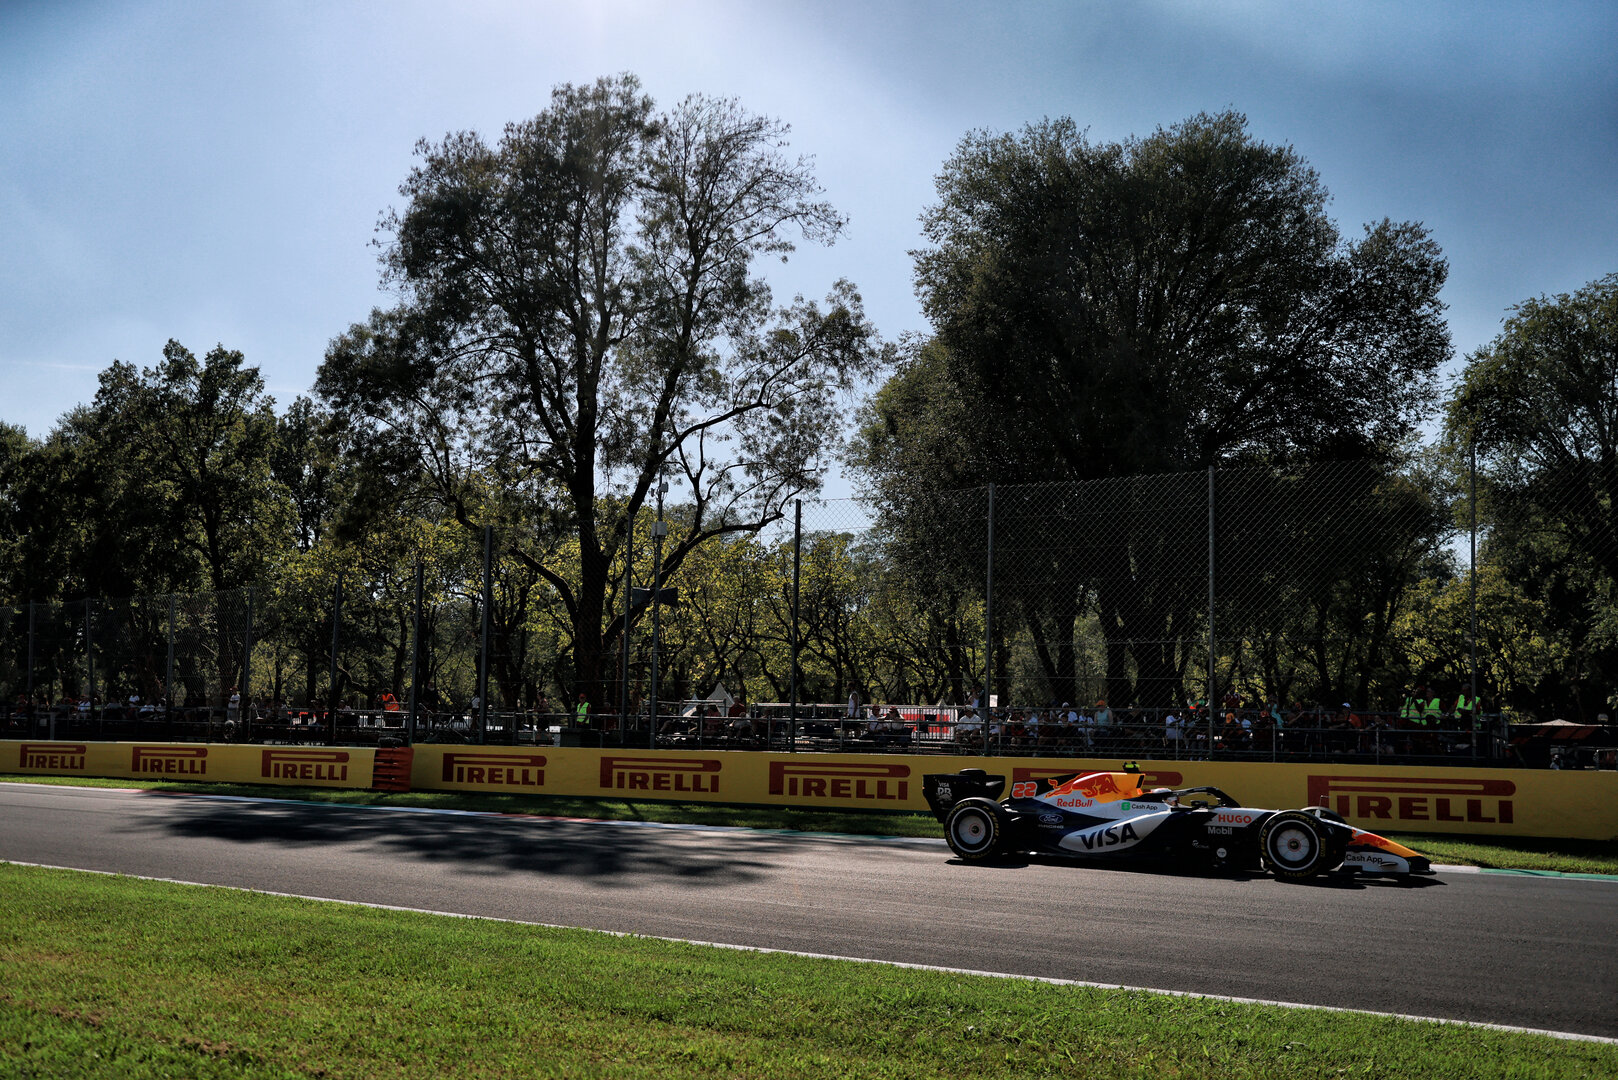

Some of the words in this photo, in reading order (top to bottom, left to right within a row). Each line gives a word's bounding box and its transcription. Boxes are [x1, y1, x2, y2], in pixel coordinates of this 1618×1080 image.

[20, 744, 87, 770] PIRELLI
[132, 746, 208, 775] PIRELLI
[261, 749, 349, 781] PIRELLI
[442, 752, 547, 786] PIRELLI
[600, 756, 722, 793] PIRELLI
[768, 760, 910, 800] PIRELLI
[1011, 781, 1038, 799] 22
[1056, 798, 1075, 808] Red
[1075, 799, 1093, 808] Bull
[1307, 775, 1516, 824] PIRELLI
[1043, 815, 1060, 824] Ford
[1207, 826, 1233, 836] Mobil
[1218, 814, 1252, 824] HUGO
[1080, 823, 1140, 850] VISA
[1346, 854, 1365, 862] Cash
[1366, 856, 1383, 864] App
